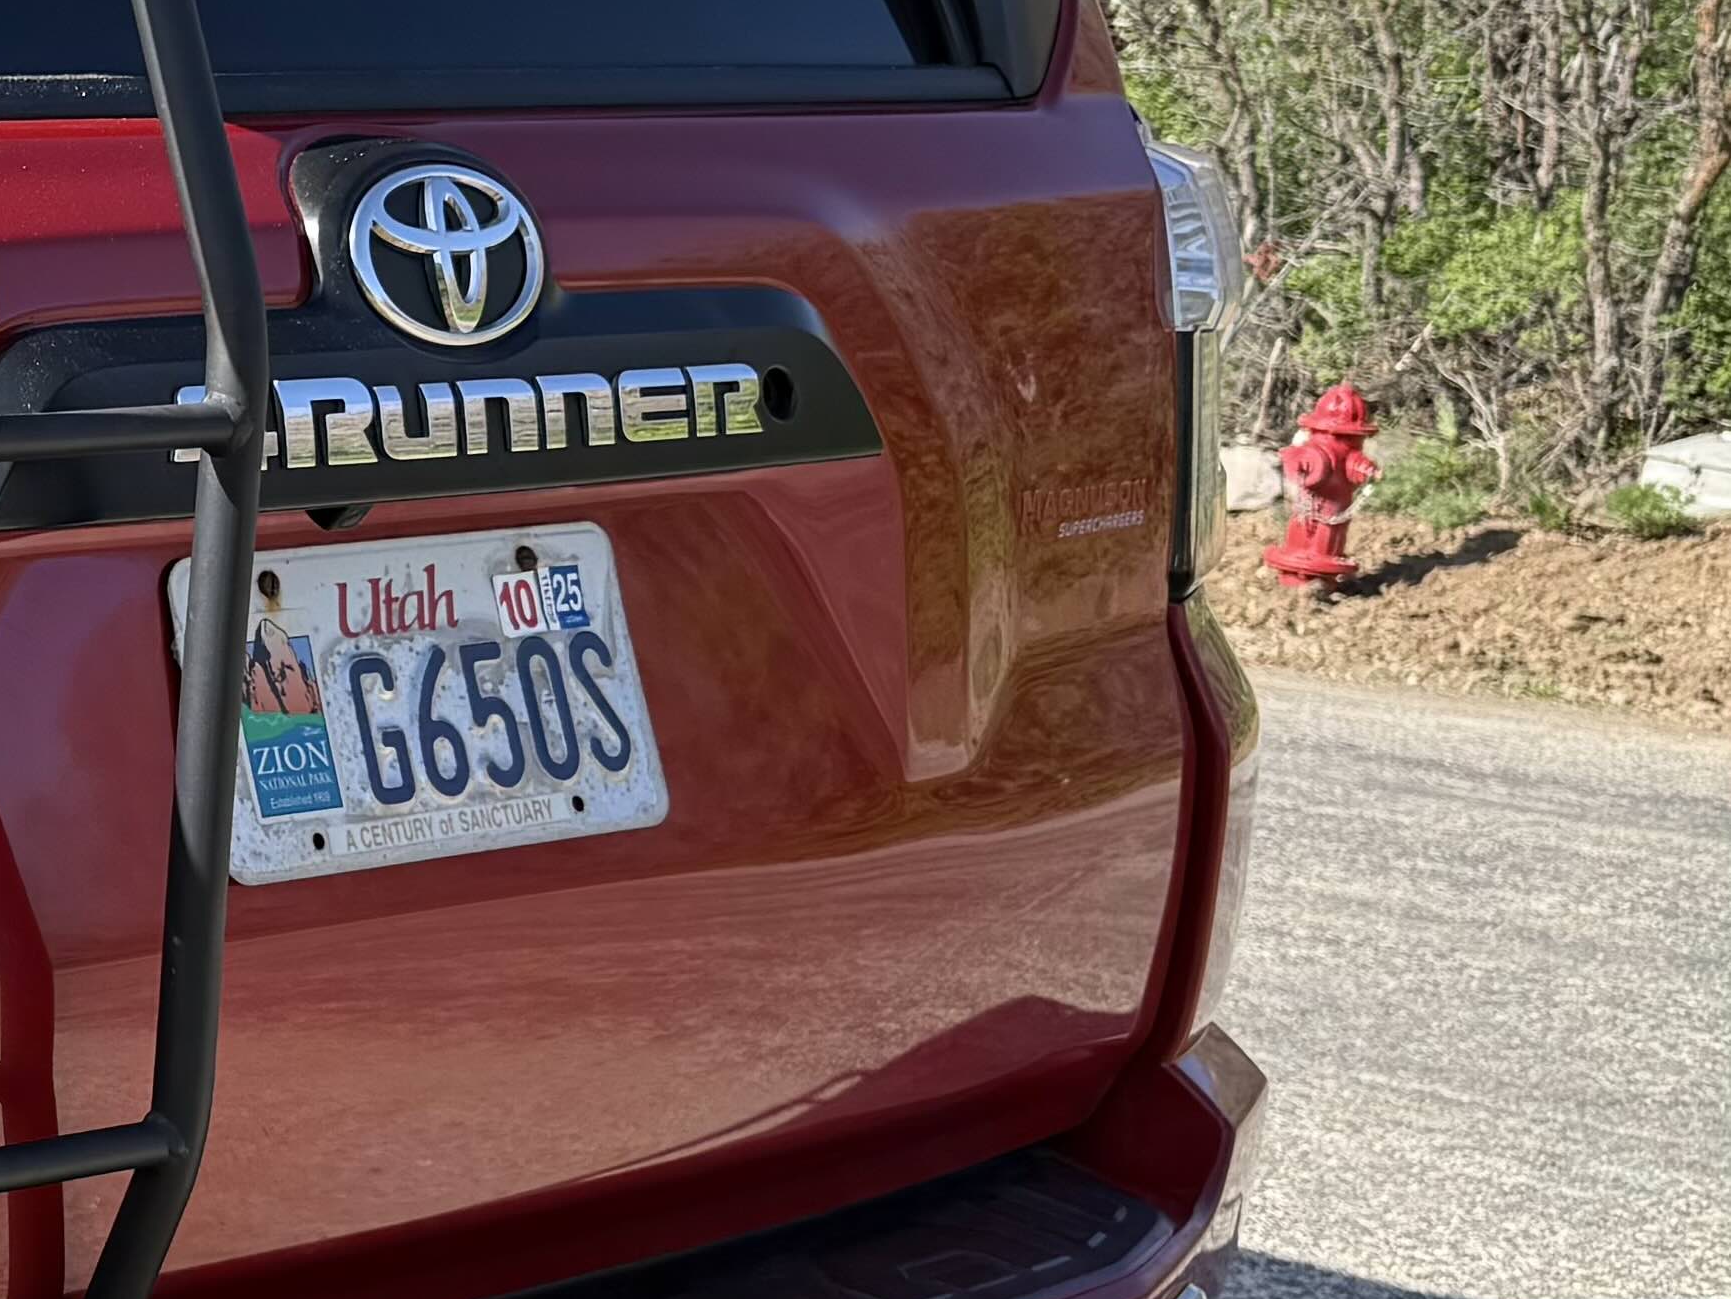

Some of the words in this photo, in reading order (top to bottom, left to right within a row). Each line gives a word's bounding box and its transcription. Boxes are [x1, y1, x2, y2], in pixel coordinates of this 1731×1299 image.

[1057, 509, 1146, 538] SUPERCHARGERS
[334, 563, 460, 639] Utah
[498, 579, 538, 631] 10
[551, 572, 584, 613] 25
[348, 630, 632, 806] G650S
[252, 739, 330, 775] ZION
[258, 773, 308, 791] NATIONAL
[308, 771, 334, 786] PARK
[345, 829, 358, 852] A
[360, 815, 435, 849] CENTURY
[439, 813, 456, 836] of
[457, 797, 554, 833] SANCTUARY
